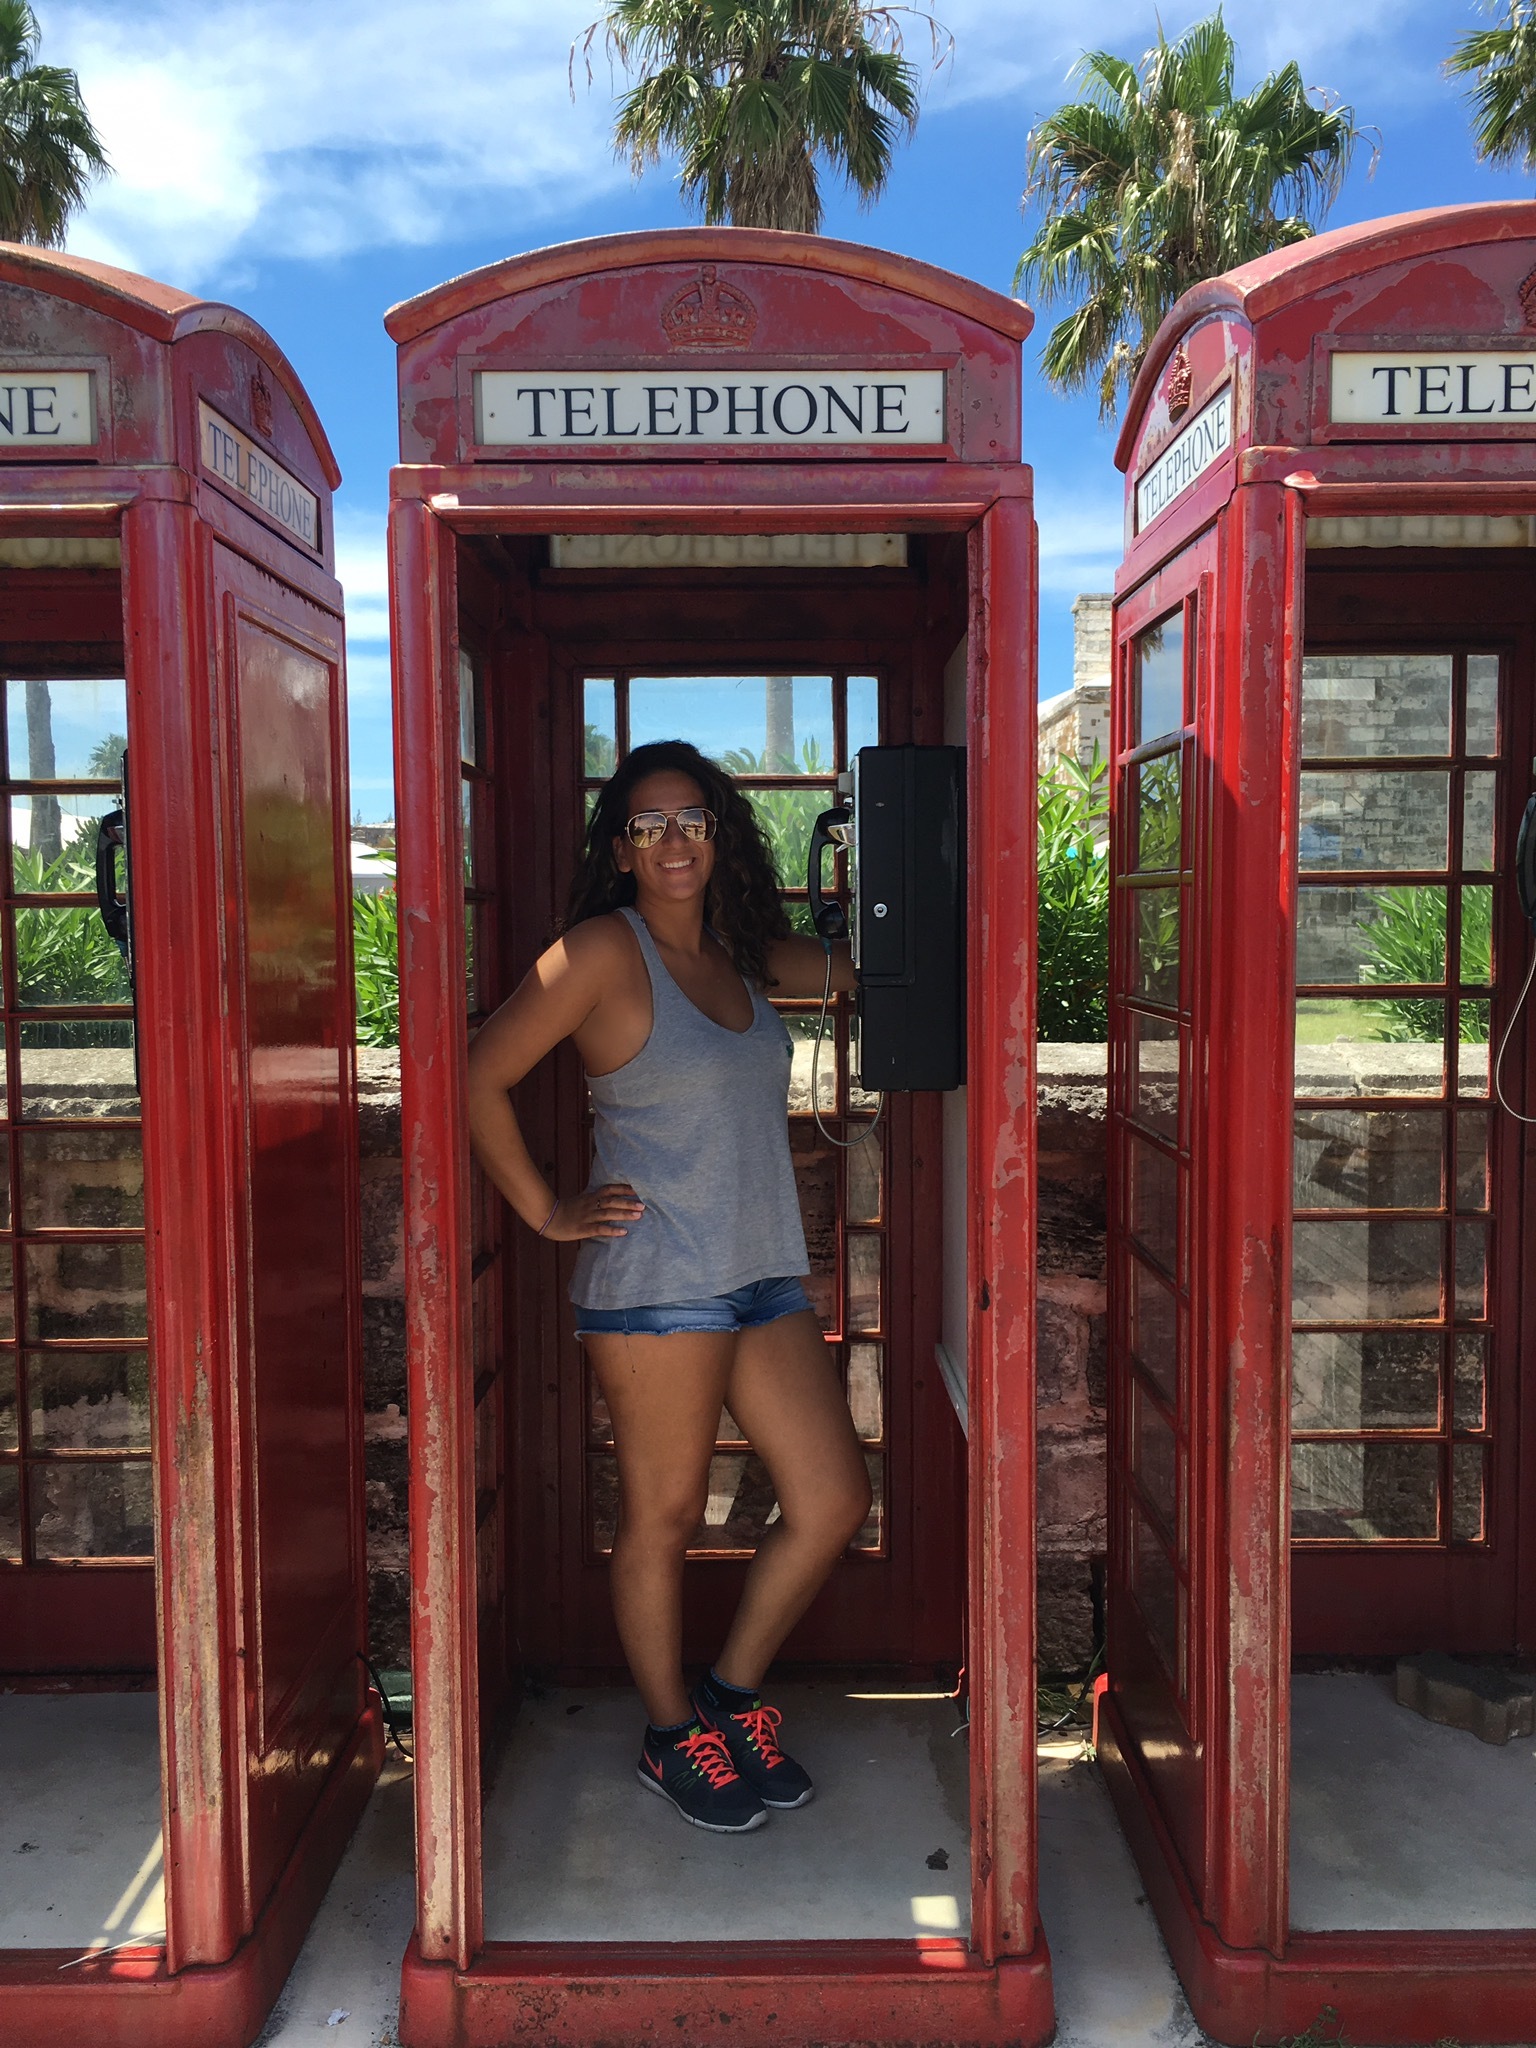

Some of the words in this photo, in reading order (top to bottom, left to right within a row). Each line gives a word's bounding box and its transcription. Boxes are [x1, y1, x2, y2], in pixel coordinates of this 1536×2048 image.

[517, 384, 910, 438] TELEPHONE
[1372, 364, 1536, 416] TELE
[208, 421, 312, 540] TELEPHONE
[1143, 399, 1228, 523] TELEPHONE
